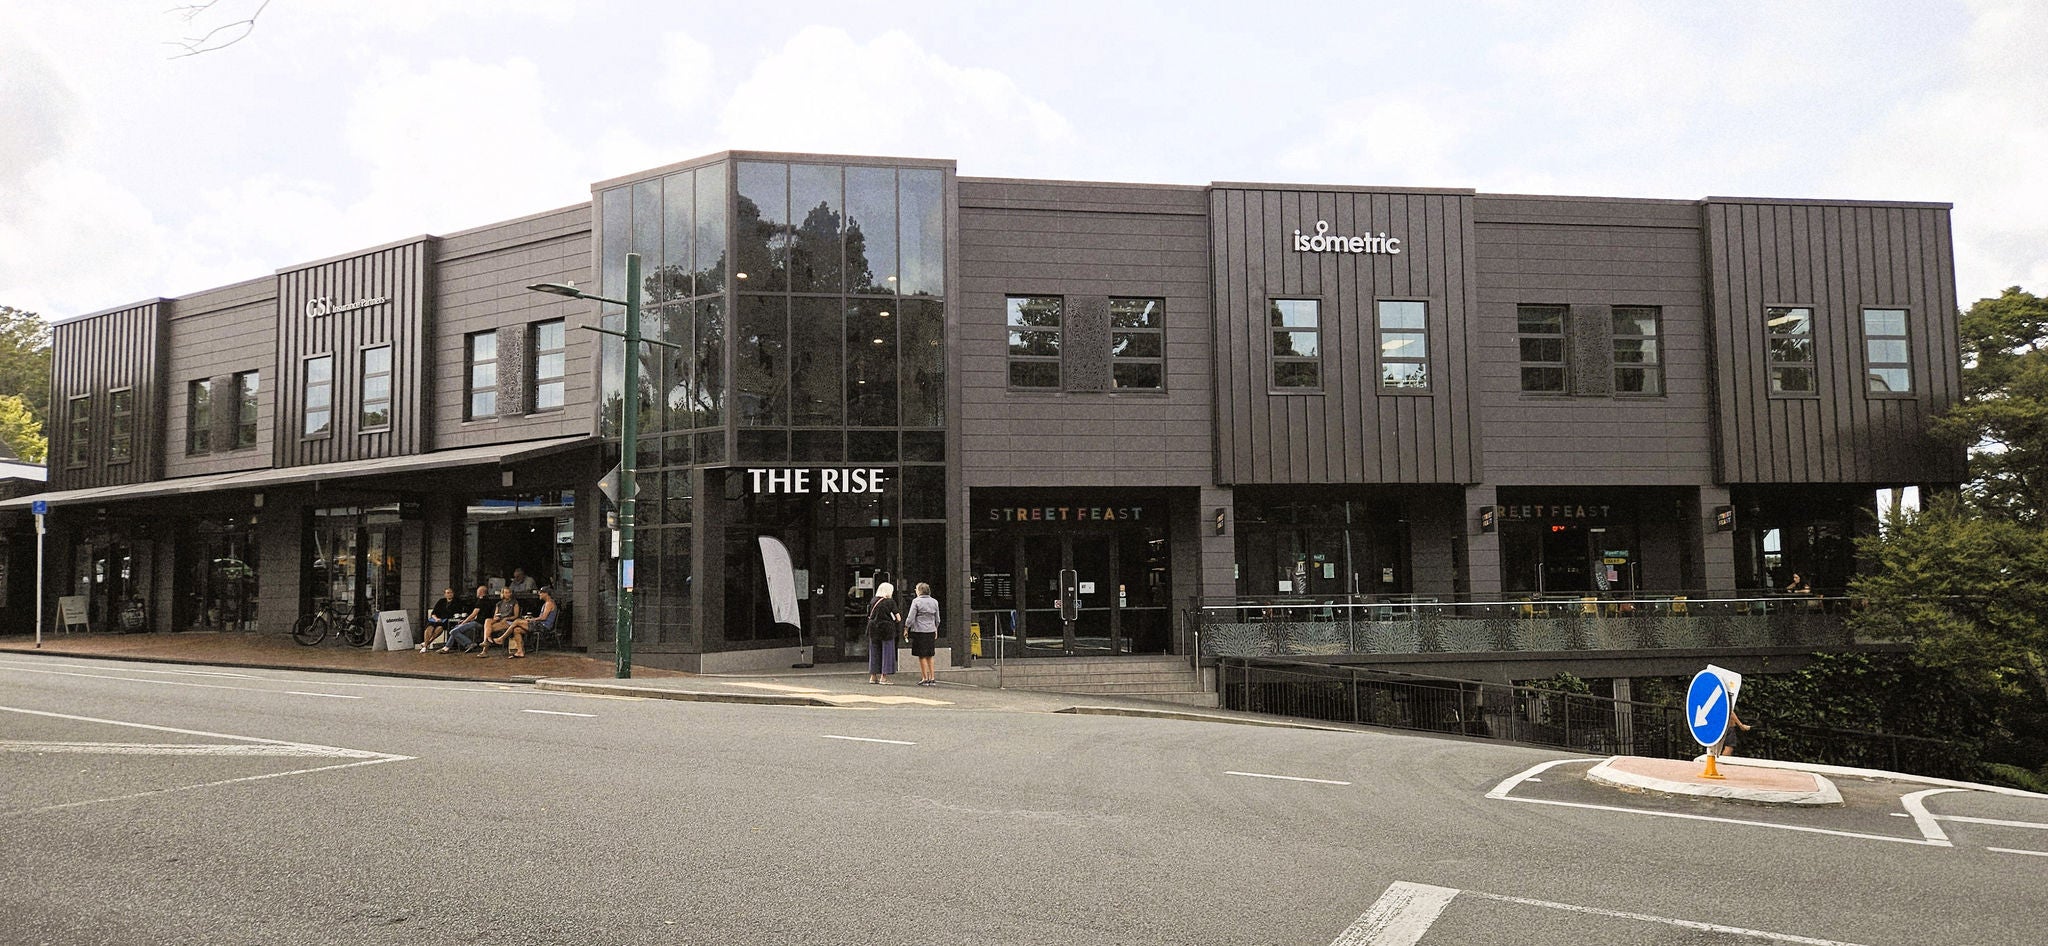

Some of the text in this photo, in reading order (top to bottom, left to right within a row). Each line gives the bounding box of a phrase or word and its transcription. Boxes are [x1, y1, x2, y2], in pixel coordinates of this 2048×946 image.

[1294, 220, 1401, 254] isometric
[332, 302, 360, 313] Insurance
[360, 296, 386, 307] Partners
[747, 468, 884, 494] THE RISE
[989, 507, 1143, 521] STREET FEAST
[1497, 505, 1610, 518] REET FEAST
